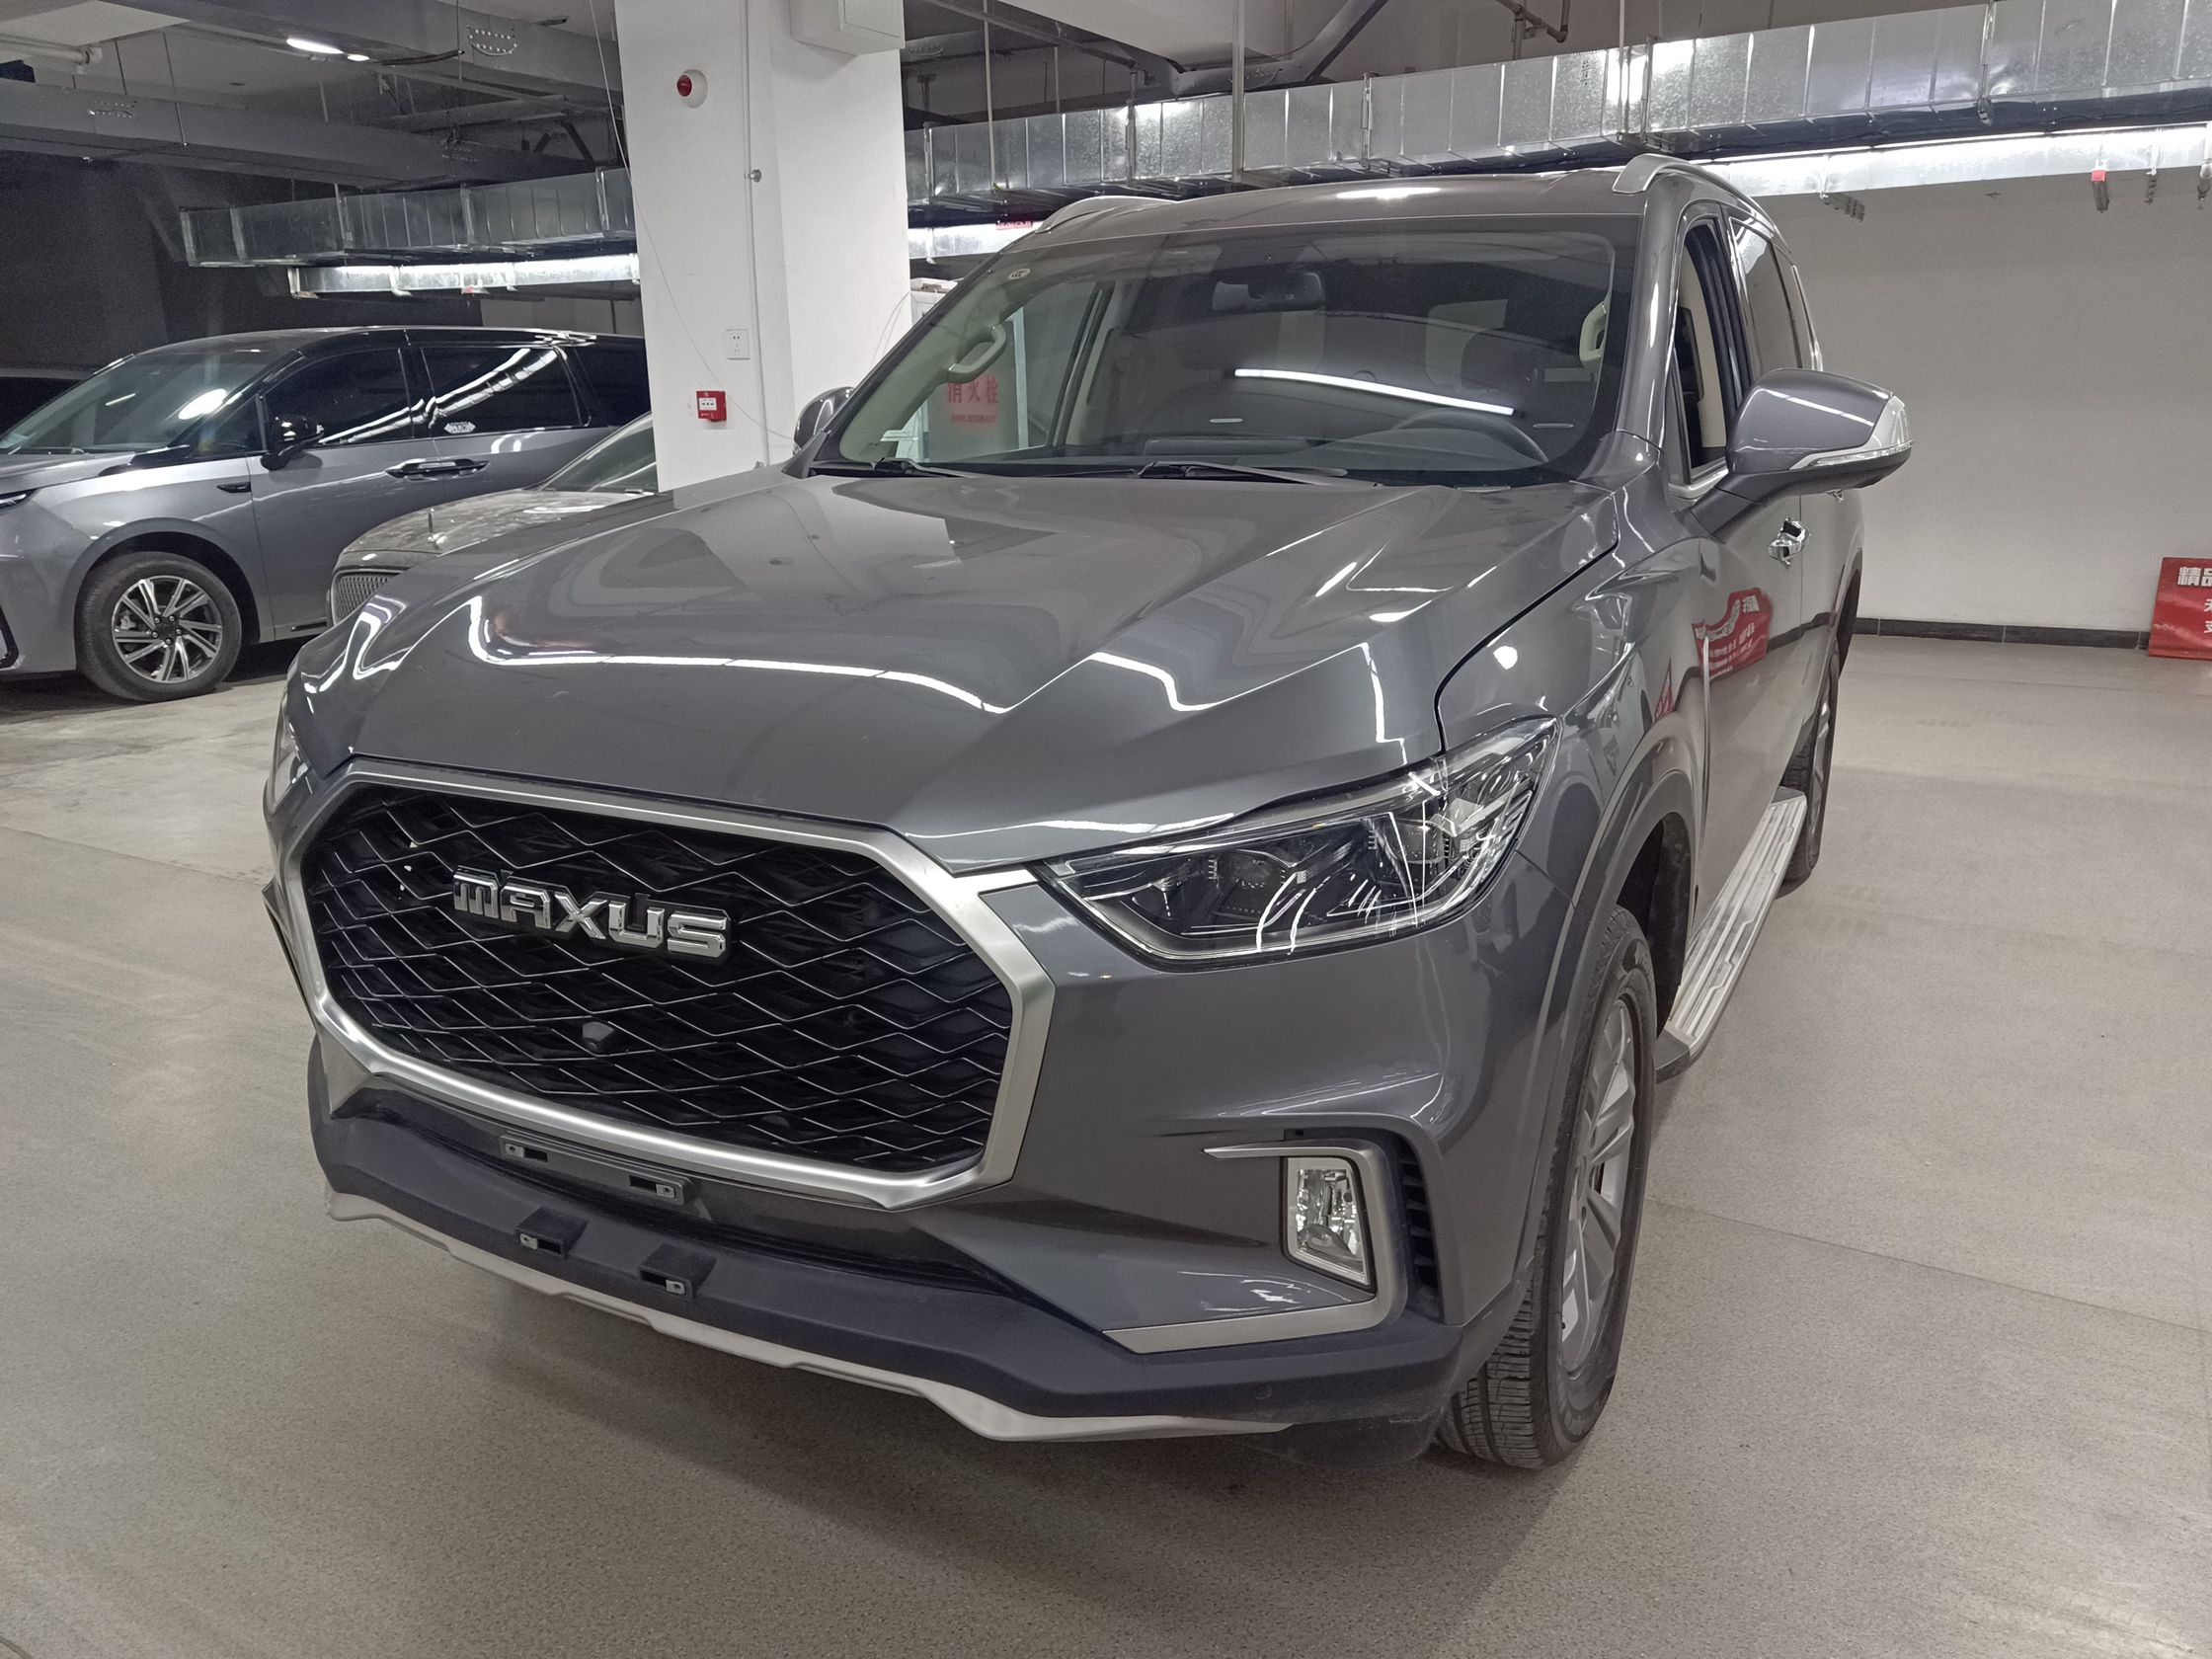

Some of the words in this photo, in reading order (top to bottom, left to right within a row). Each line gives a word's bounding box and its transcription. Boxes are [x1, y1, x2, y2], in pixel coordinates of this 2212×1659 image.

[947, 375, 999, 403] 消火栓
[452, 870, 728, 959] MAXUS
